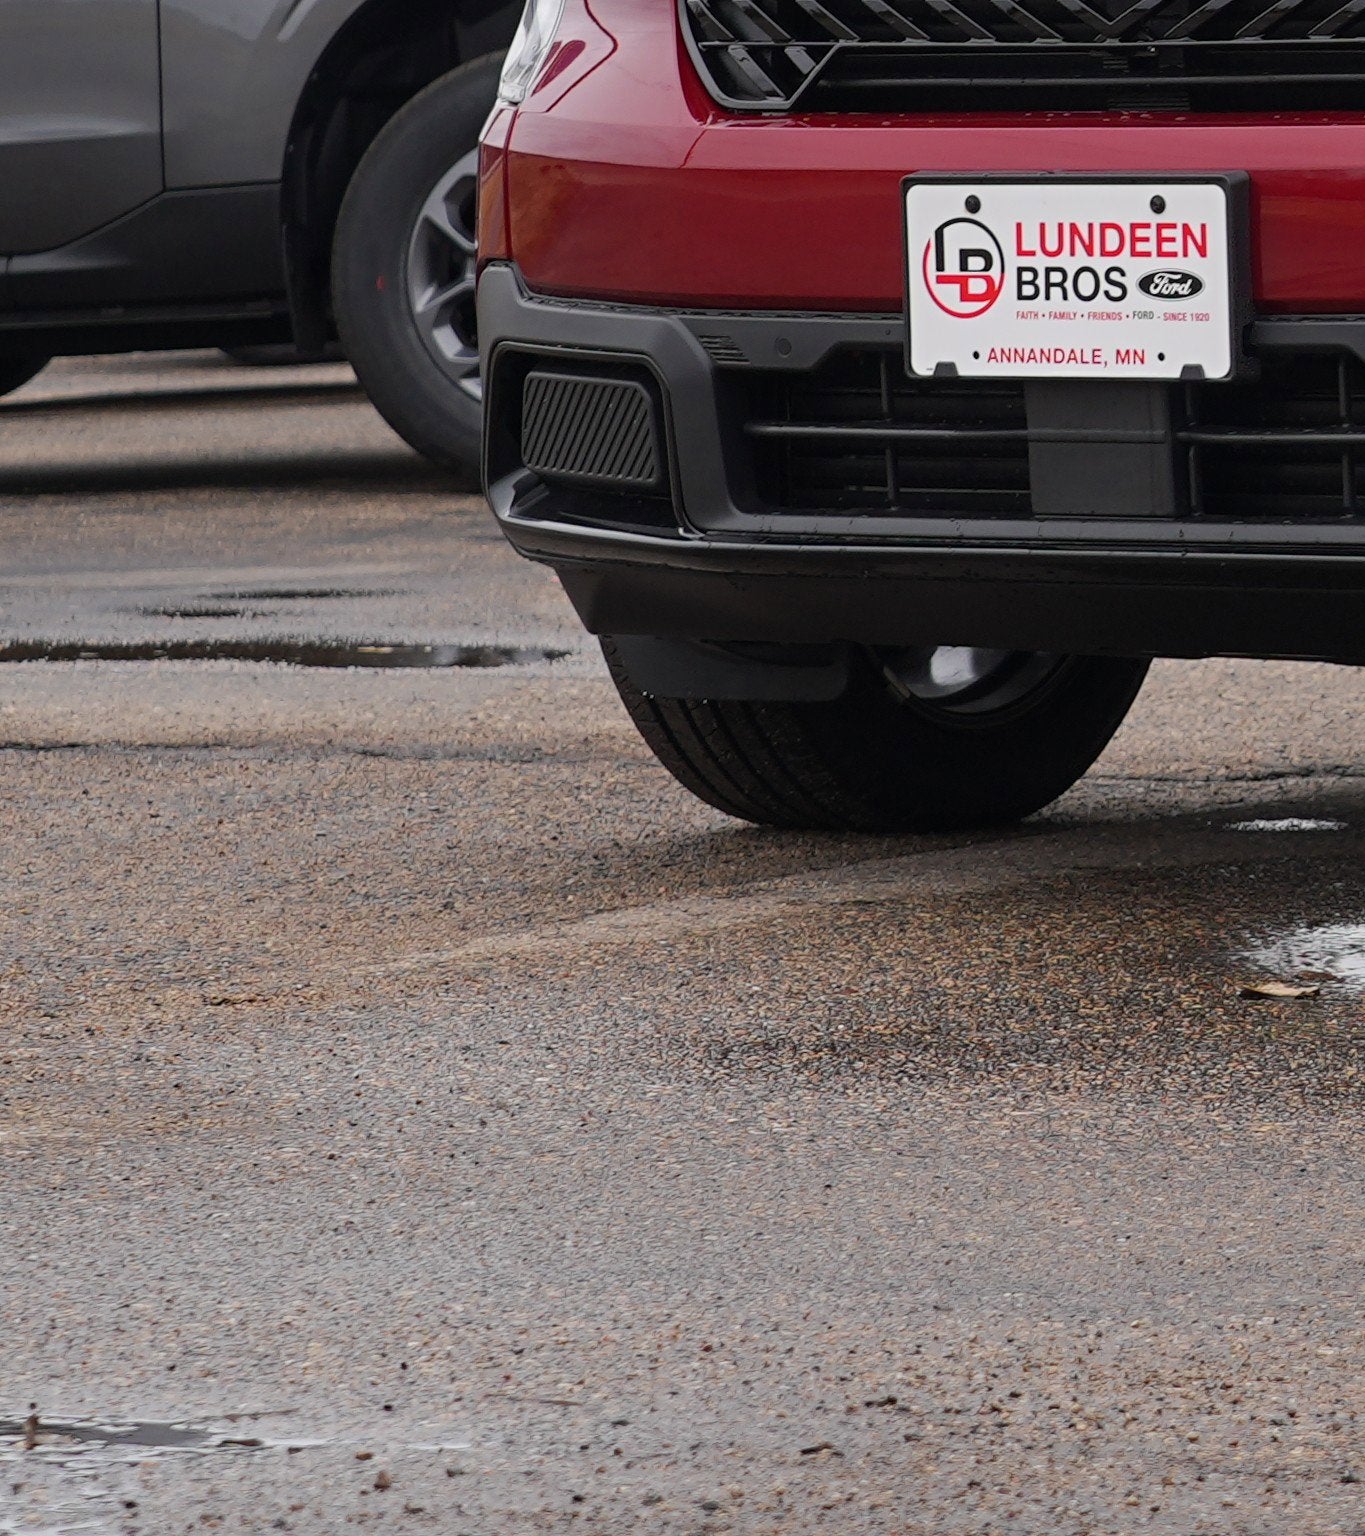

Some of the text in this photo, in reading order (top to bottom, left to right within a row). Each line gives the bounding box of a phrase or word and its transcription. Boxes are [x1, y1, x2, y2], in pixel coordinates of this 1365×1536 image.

[1015, 222, 1208, 258] LUNDEEN
[1016, 265, 1128, 302] BROS
[1149, 272, 1193, 295] Ford
[1016, 310, 1039, 321] FAITH
[1048, 310, 1078, 321] FAMILY
[1087, 311, 1123, 321] FRIENDS
[1132, 310, 1155, 321] FORD
[1162, 312, 1188, 322] SINCE
[987, 348, 1146, 368] ANNANDALE, MN
